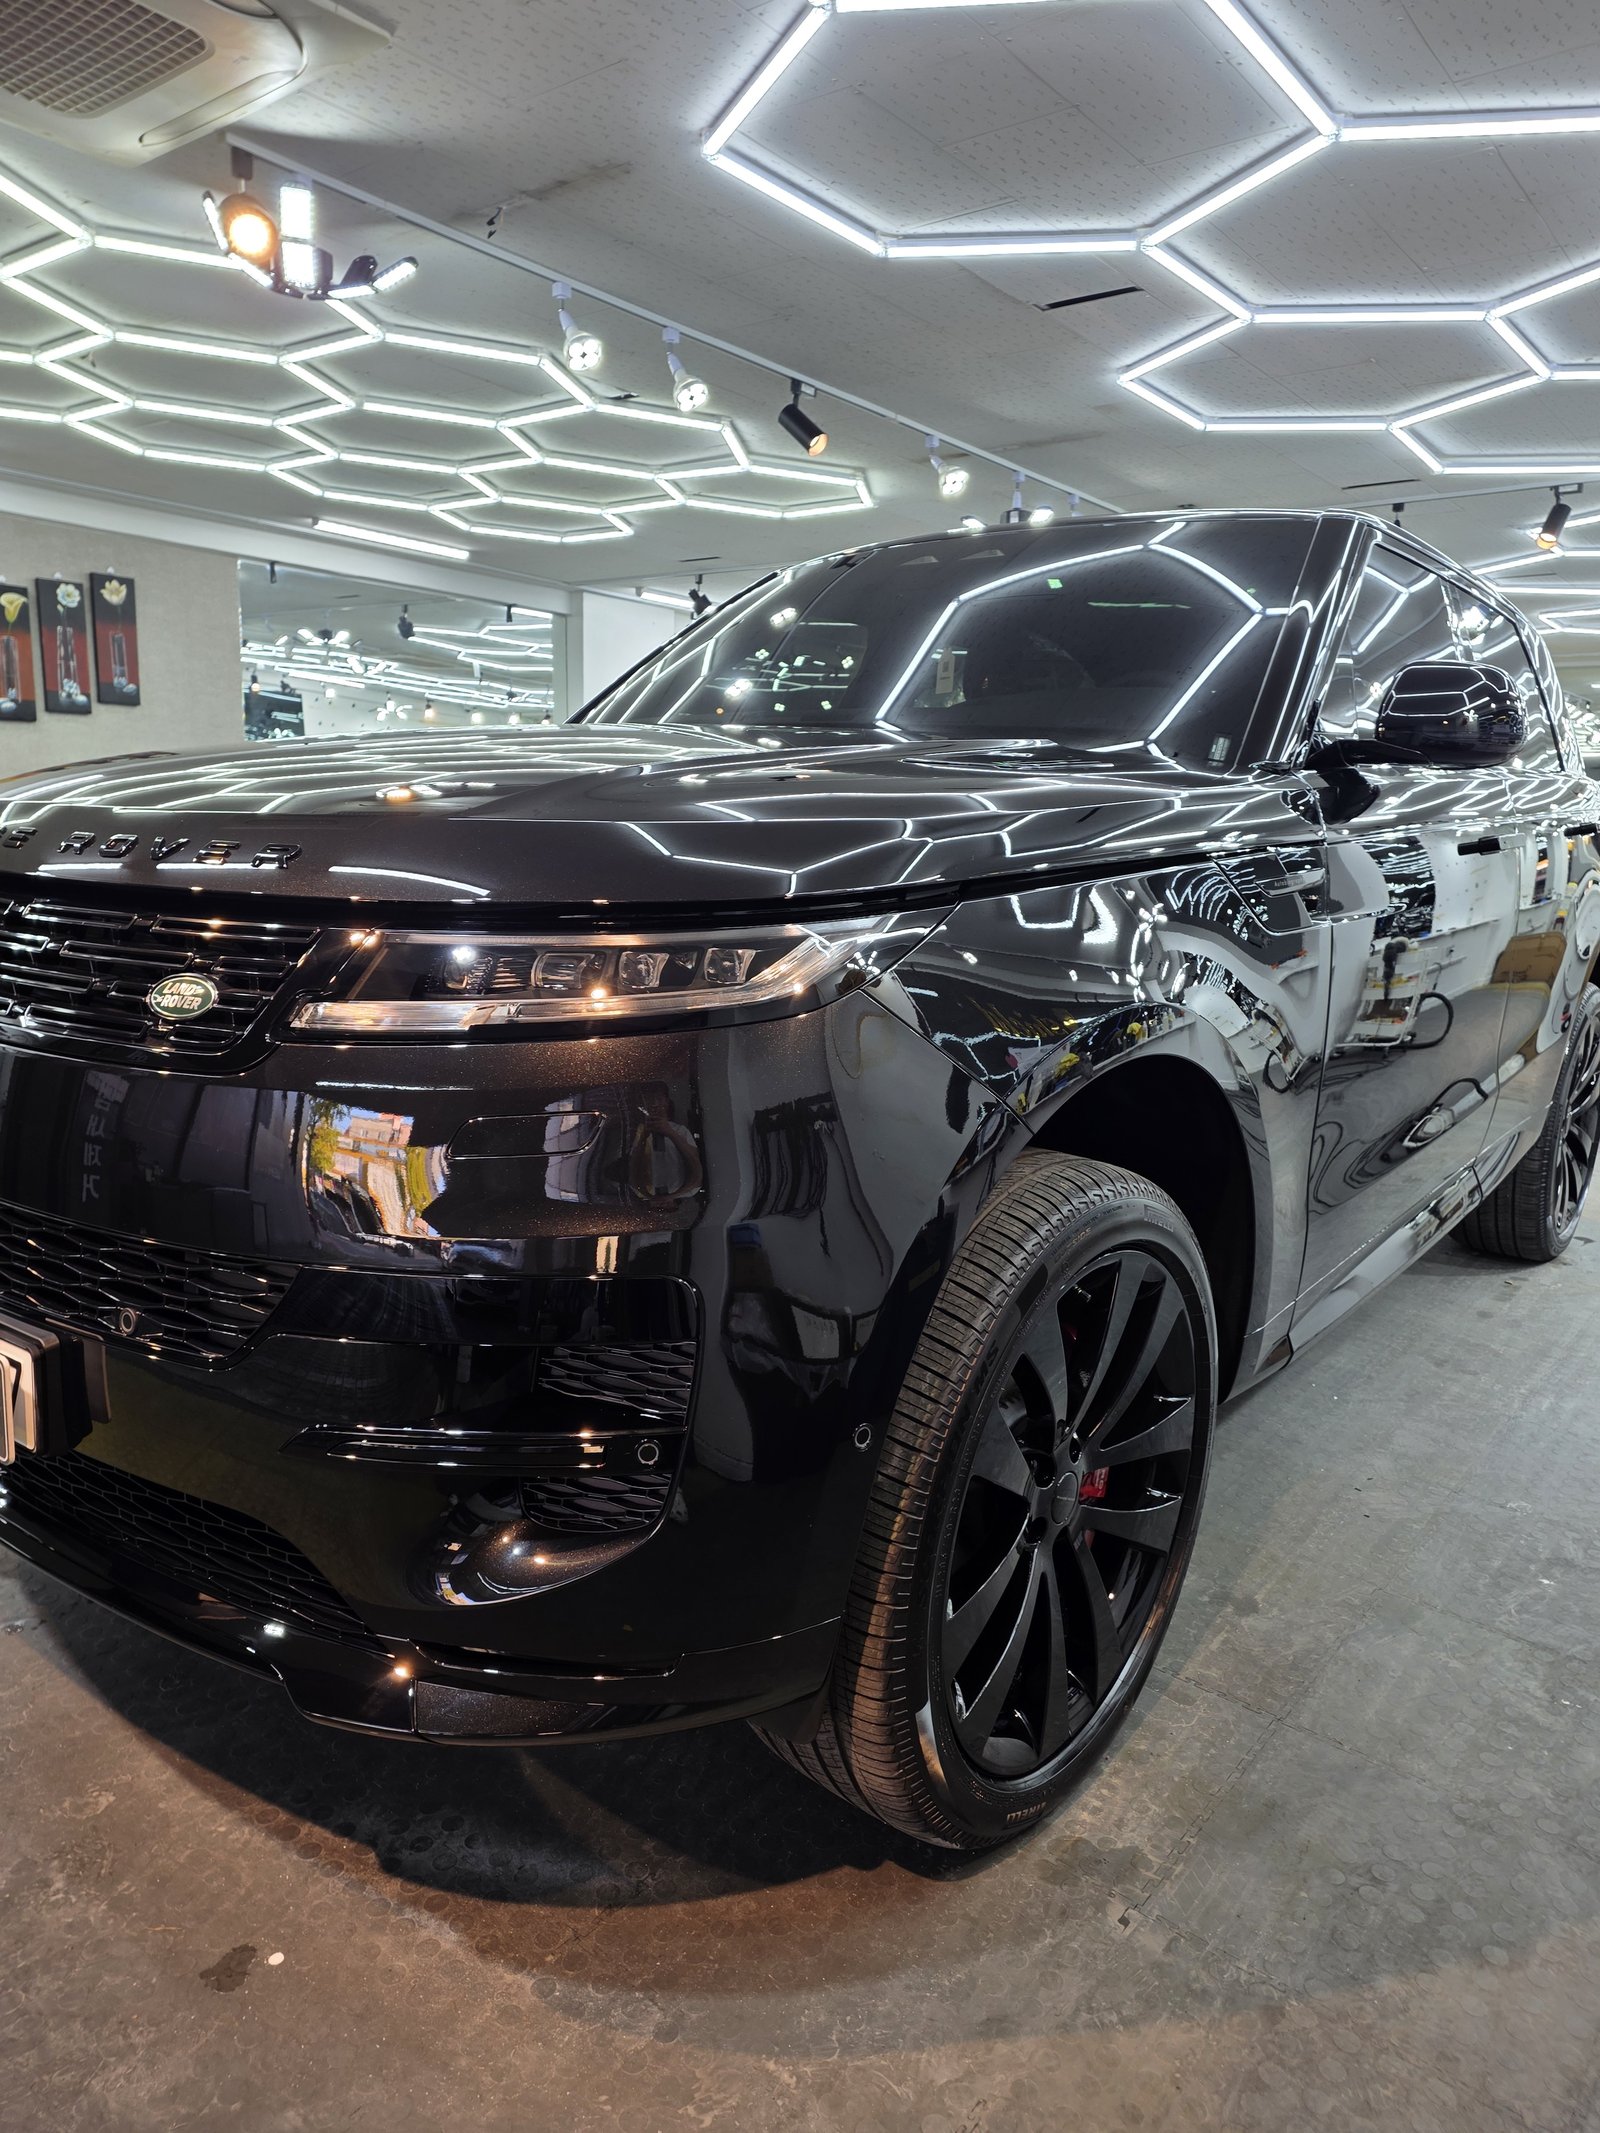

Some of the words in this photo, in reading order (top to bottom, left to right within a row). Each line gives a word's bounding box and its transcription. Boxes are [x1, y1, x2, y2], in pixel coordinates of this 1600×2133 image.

[57, 831, 302, 869] ROVER
[163, 981, 196, 995] LAND
[160, 994, 202, 1010] ROVER
